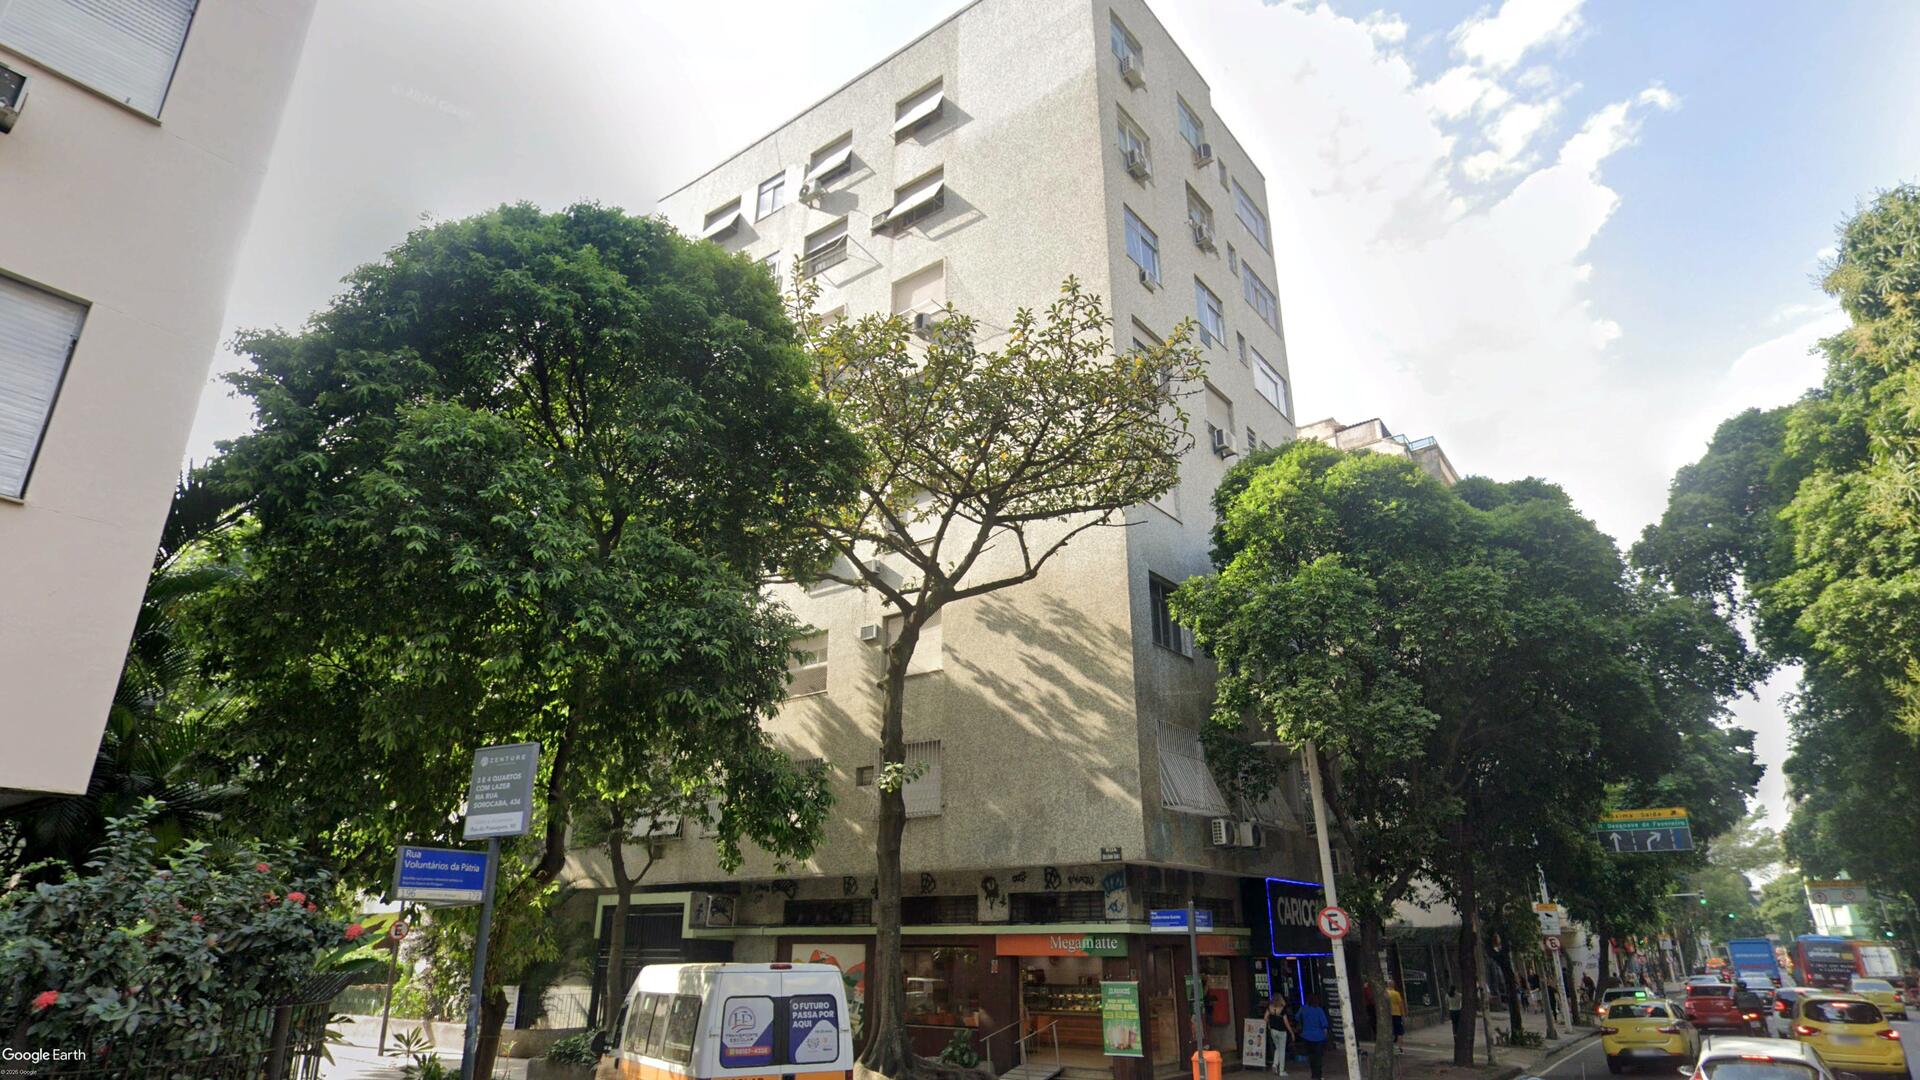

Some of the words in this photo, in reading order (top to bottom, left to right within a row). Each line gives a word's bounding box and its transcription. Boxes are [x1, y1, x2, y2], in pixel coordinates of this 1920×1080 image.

[492, 773, 522, 782] QUARTOS
[491, 782, 511, 790] LAZER
[406, 849, 422, 858] Rua
[404, 860, 449, 870] Voluntários
[450, 862, 460, 871] da
[461, 863, 480, 872] Pátria
[1050, 936, 1118, 952] Megamatte
[800, 1002, 829, 1010] FUTURO
[792, 1011, 818, 1019] PASSA
[818, 1010, 834, 1018] POR
[793, 1020, 812, 1029] AQUI
